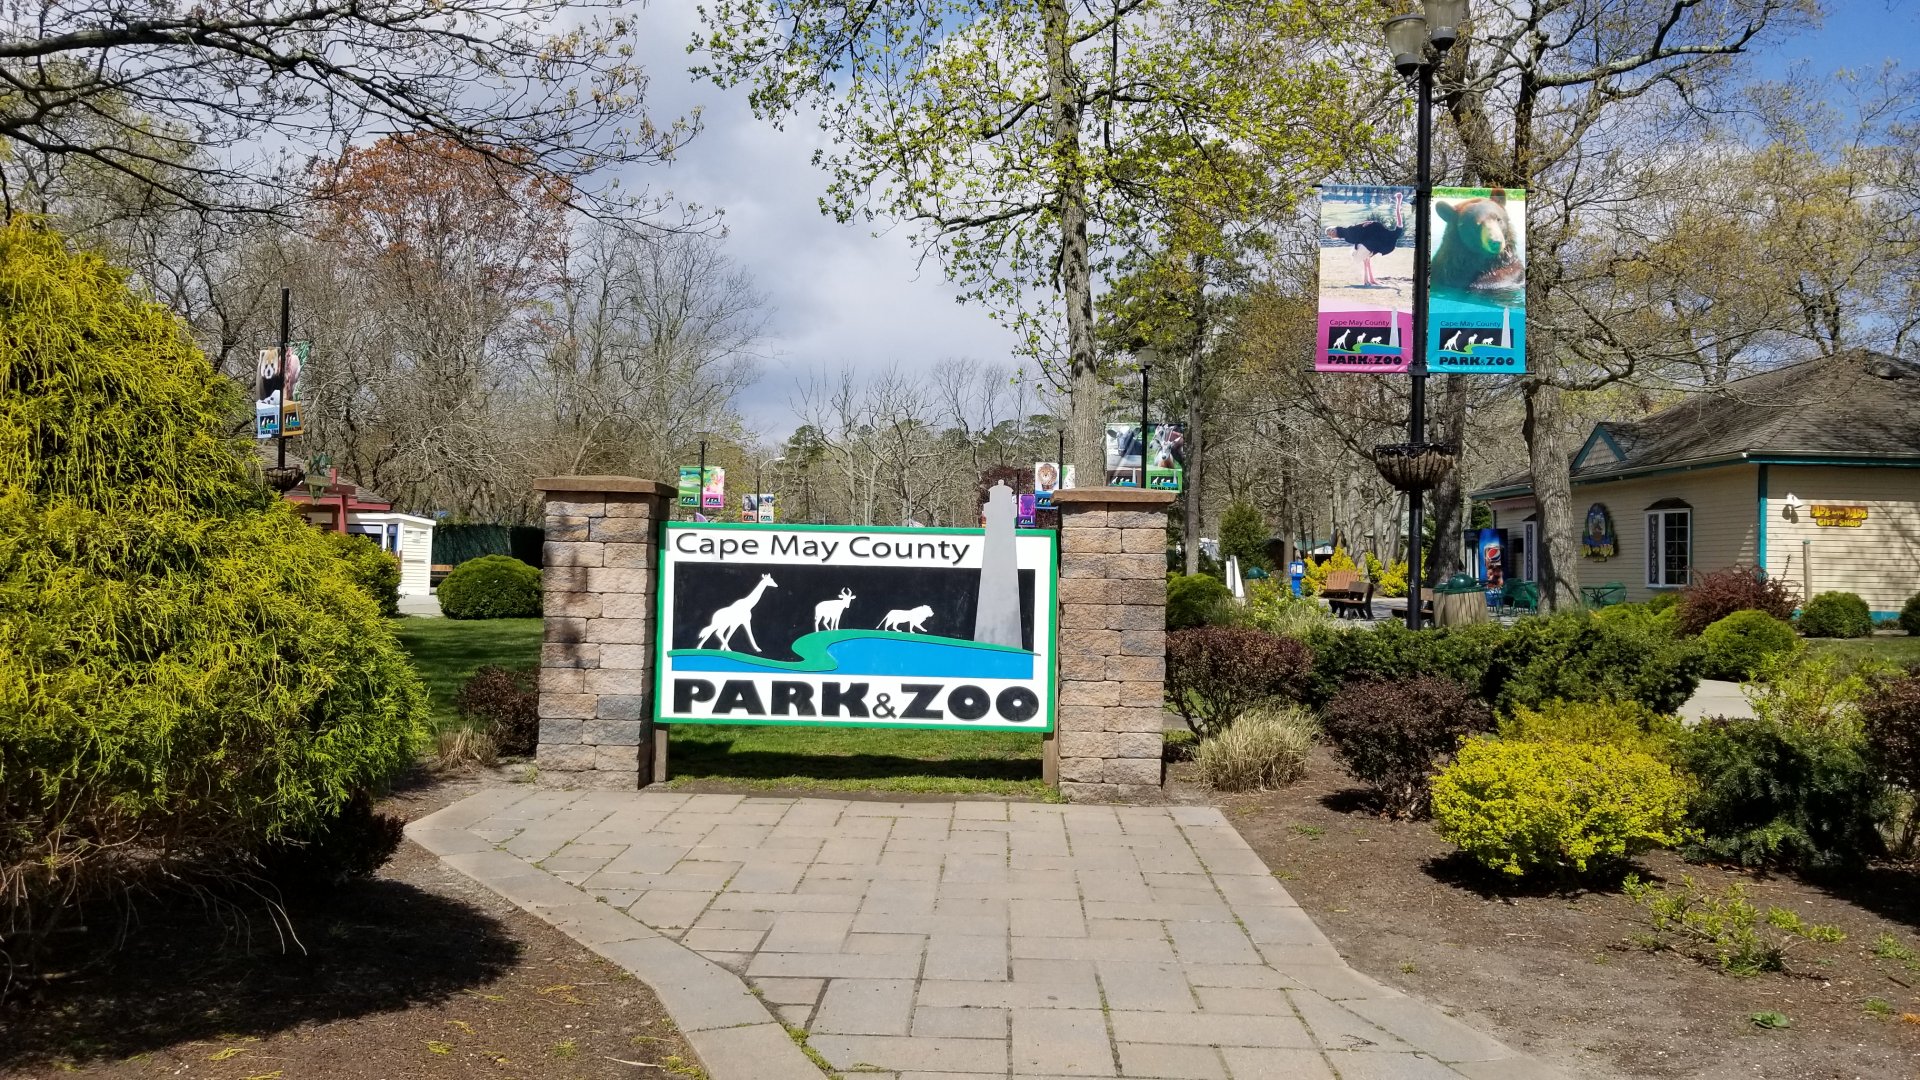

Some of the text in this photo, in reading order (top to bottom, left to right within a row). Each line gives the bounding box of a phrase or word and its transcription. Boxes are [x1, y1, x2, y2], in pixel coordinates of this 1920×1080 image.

[1329, 319, 1390, 327] Cape May County
[1440, 320, 1501, 328] Cape May County
[1817, 518, 1861, 527] GIFT SHOP
[675, 532, 971, 566] Cape May County
